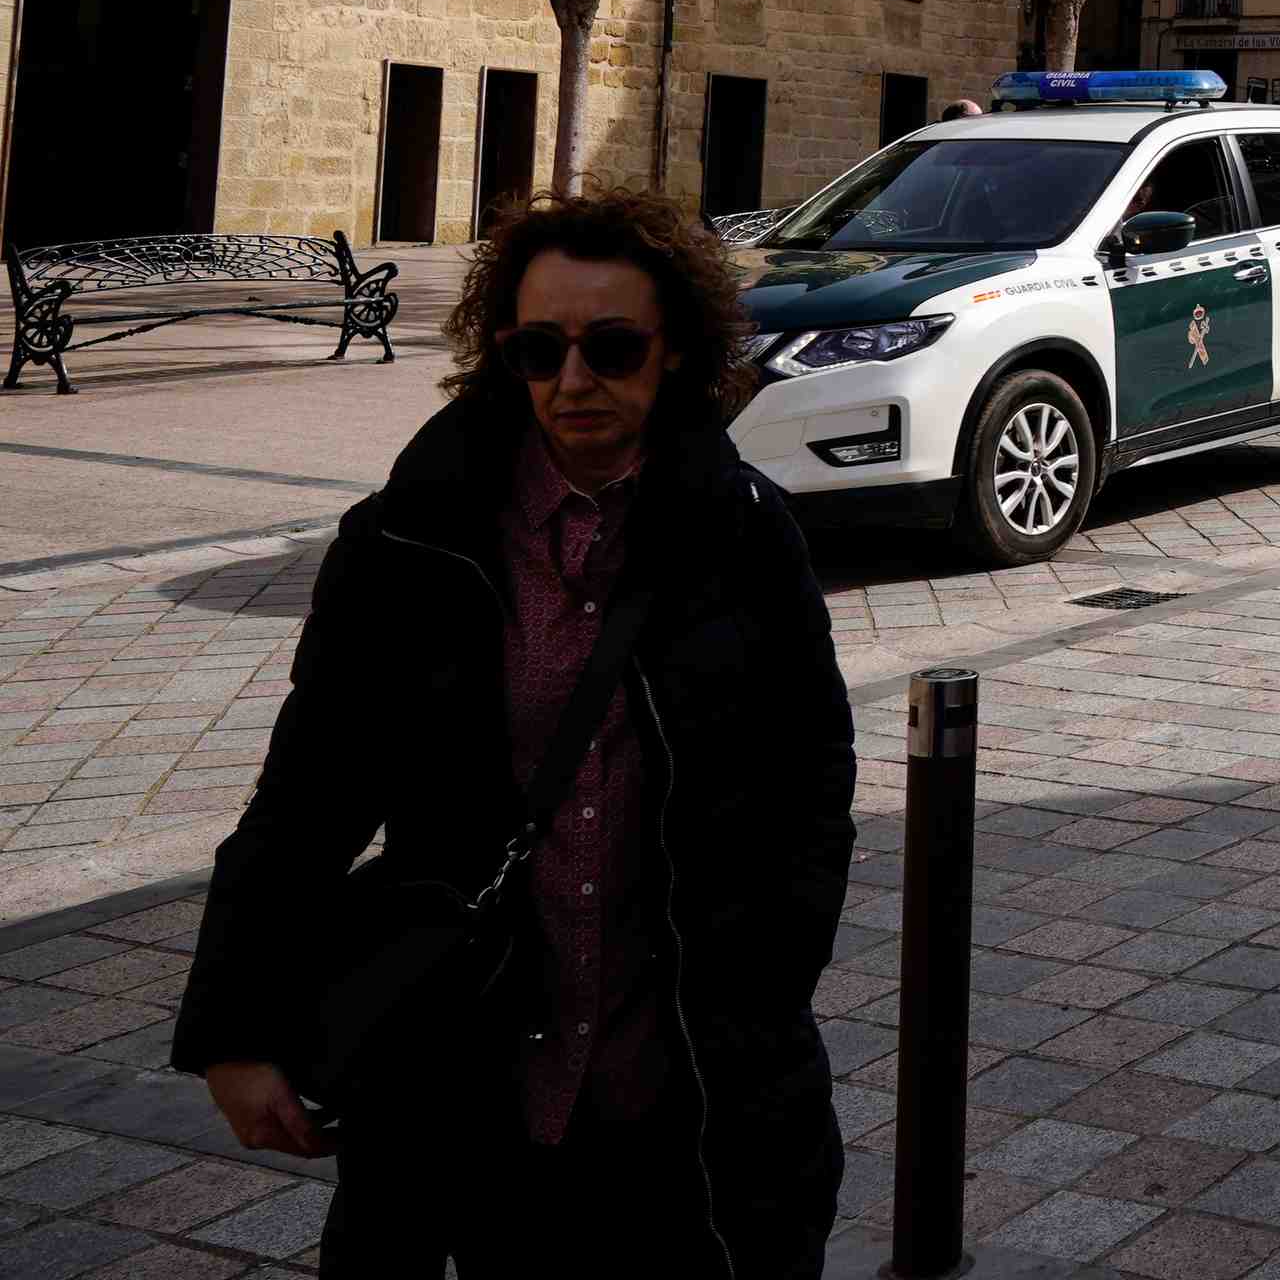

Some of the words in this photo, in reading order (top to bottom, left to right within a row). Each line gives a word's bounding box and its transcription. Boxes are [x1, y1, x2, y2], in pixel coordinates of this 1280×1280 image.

[1045, 72, 1091, 80] GUARDIA
[1049, 79, 1077, 88] CIVIL
[1004, 281, 1052, 296] GUARDIA
[1053, 278, 1078, 290] CIVIL
